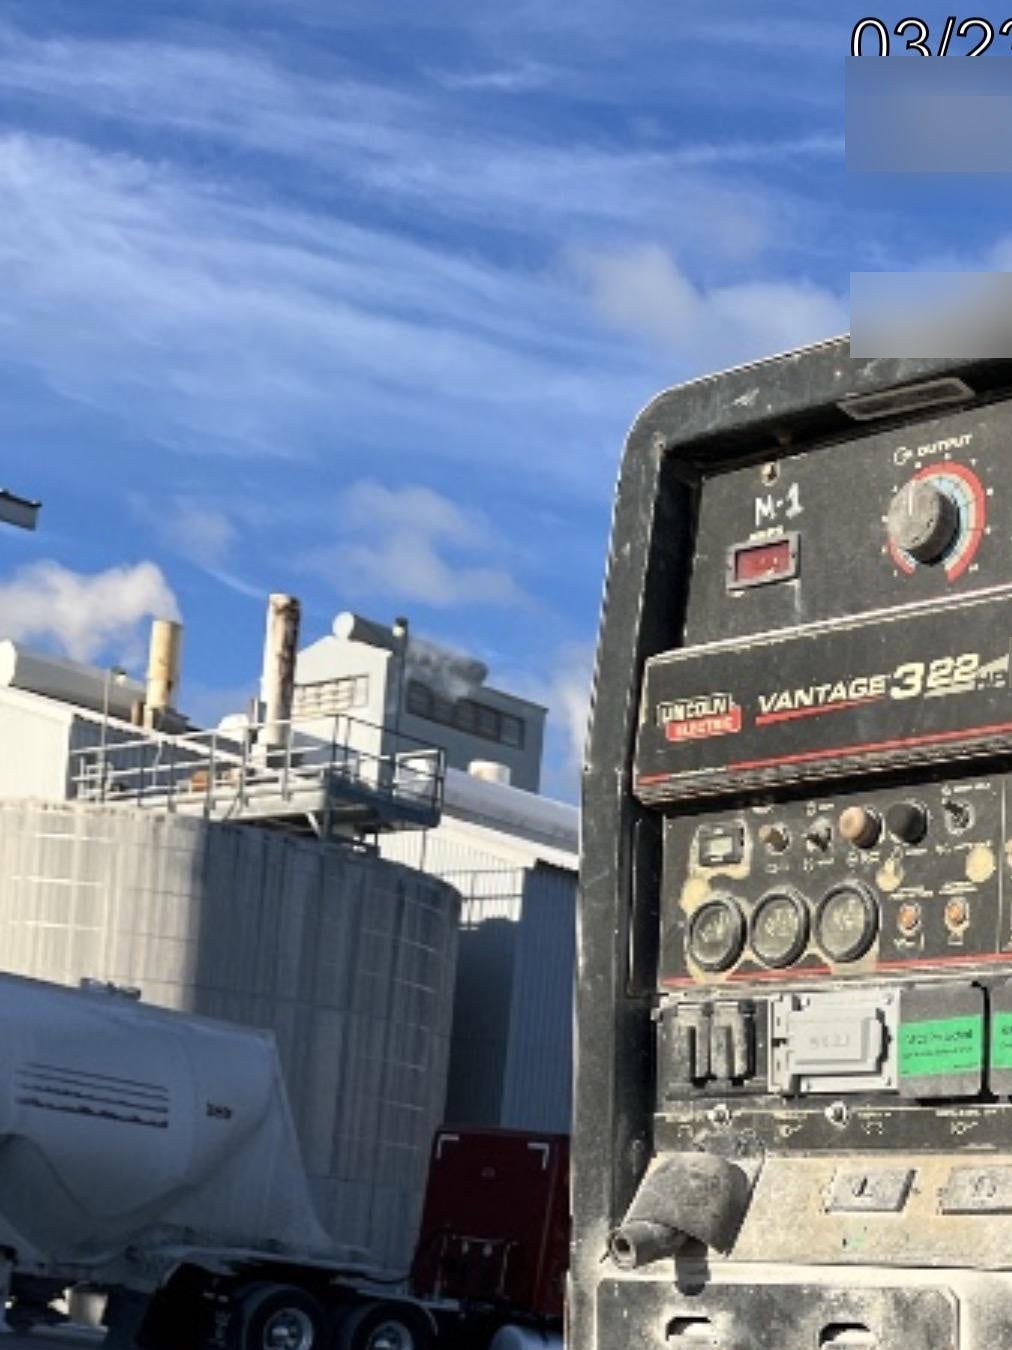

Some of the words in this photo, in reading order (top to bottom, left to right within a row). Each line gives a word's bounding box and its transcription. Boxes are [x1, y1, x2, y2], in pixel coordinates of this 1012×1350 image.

[917, 434, 973, 456] OUTPUT
[757, 674, 886, 714] VANTAGE
[890, 652, 979, 700] 322
[660, 696, 728, 723] LINCOLN
